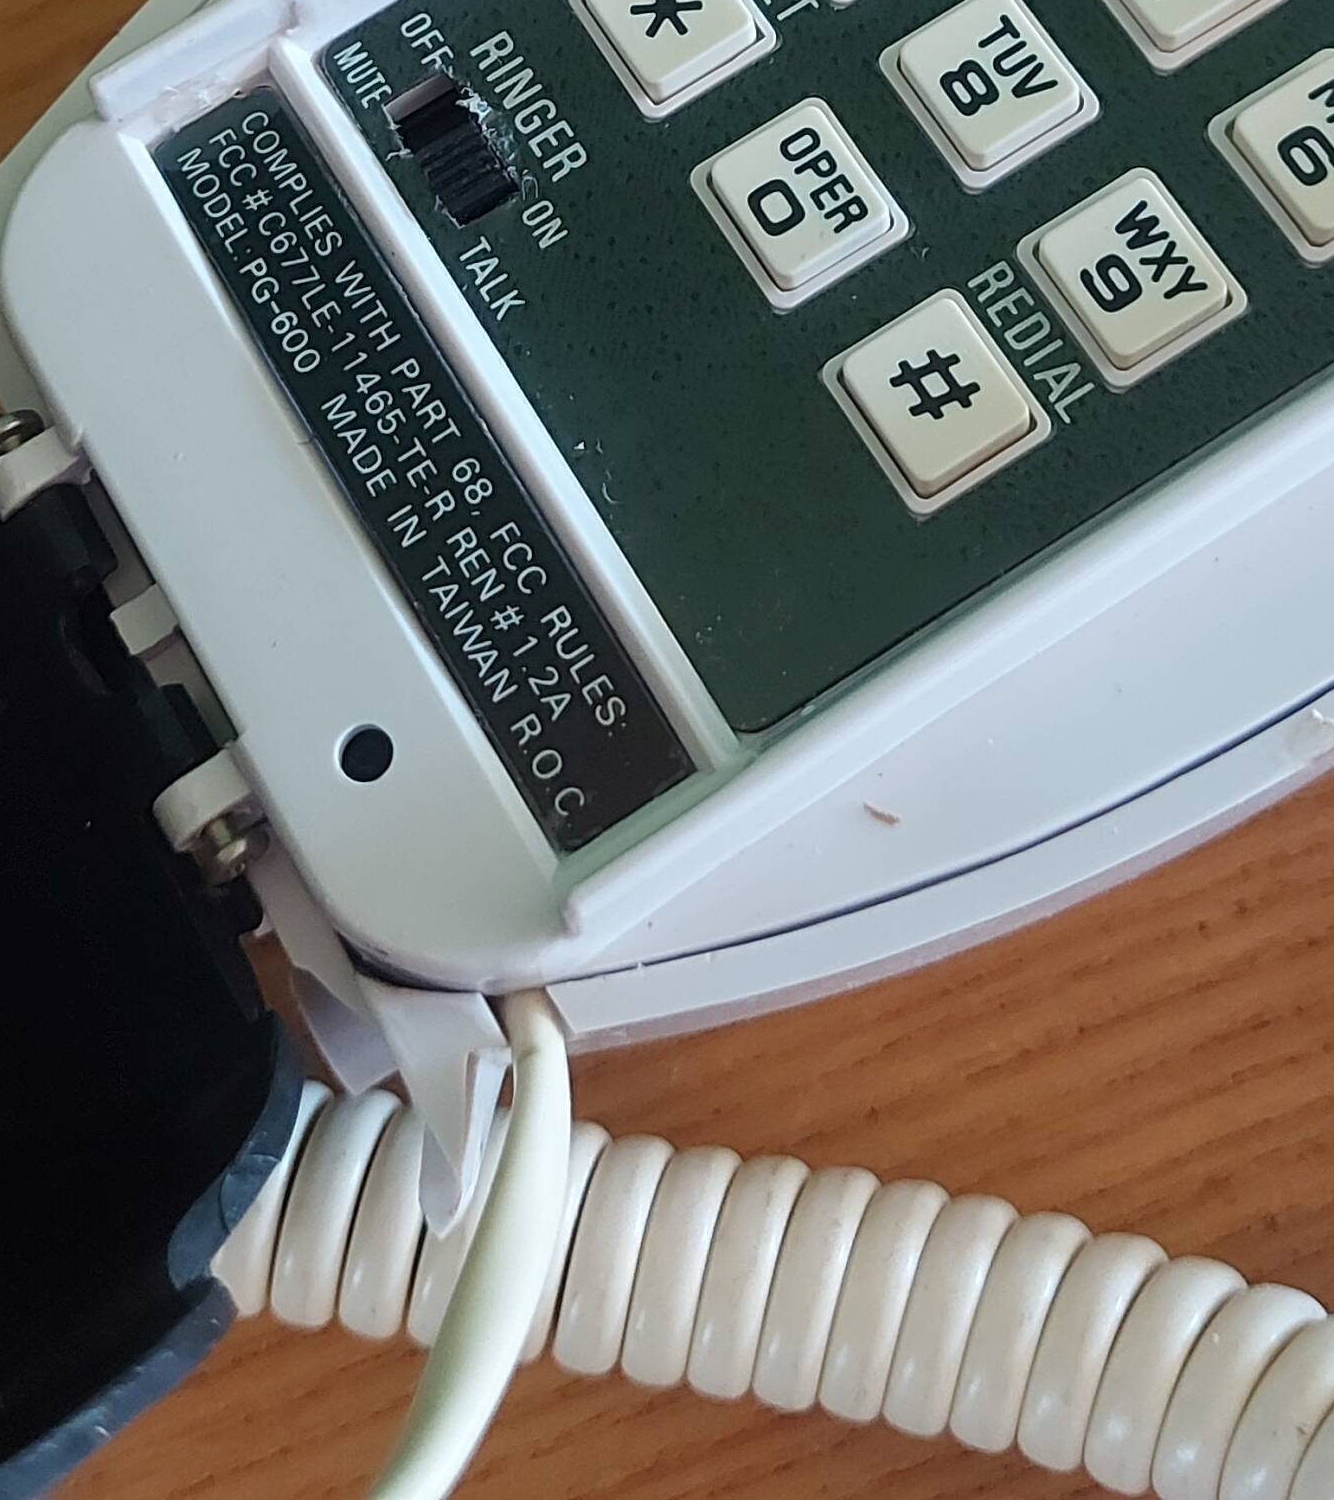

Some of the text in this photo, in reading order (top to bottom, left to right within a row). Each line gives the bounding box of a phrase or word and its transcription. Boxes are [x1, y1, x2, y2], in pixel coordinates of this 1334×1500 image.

[333, 41, 393, 109] MUTE
[400, 12, 455, 69] OFF
[977, 13, 1059, 99] TUV
[469, 31, 588, 183] RINGER
[939, 59, 1000, 117] 8
[521, 200, 568, 249] ON
[778, 126, 869, 234] OPER
[458, 235, 526, 321] TALK
[1079, 254, 1144, 313] 9
[1114, 200, 1209, 301] WXY
[242, 111, 343, 257] COMPLIES
[334, 260, 402, 352] WITH
[390, 358, 462, 444] PART
[451, 457, 494, 516] 68,
[489, 521, 547, 595] FCC
[967, 260, 1098, 425] REDIAL
[177, 147, 252, 261] MODEL:
[239, 257, 321, 374] PG-600
[320, 392, 398, 497] MADE
[387, 504, 428, 548] IN
[421, 555, 519, 704] TAIWAN
[208, 128, 258, 188] FCC
[446, 526, 506, 602] REN
[513, 635, 572, 722] 1.2A
